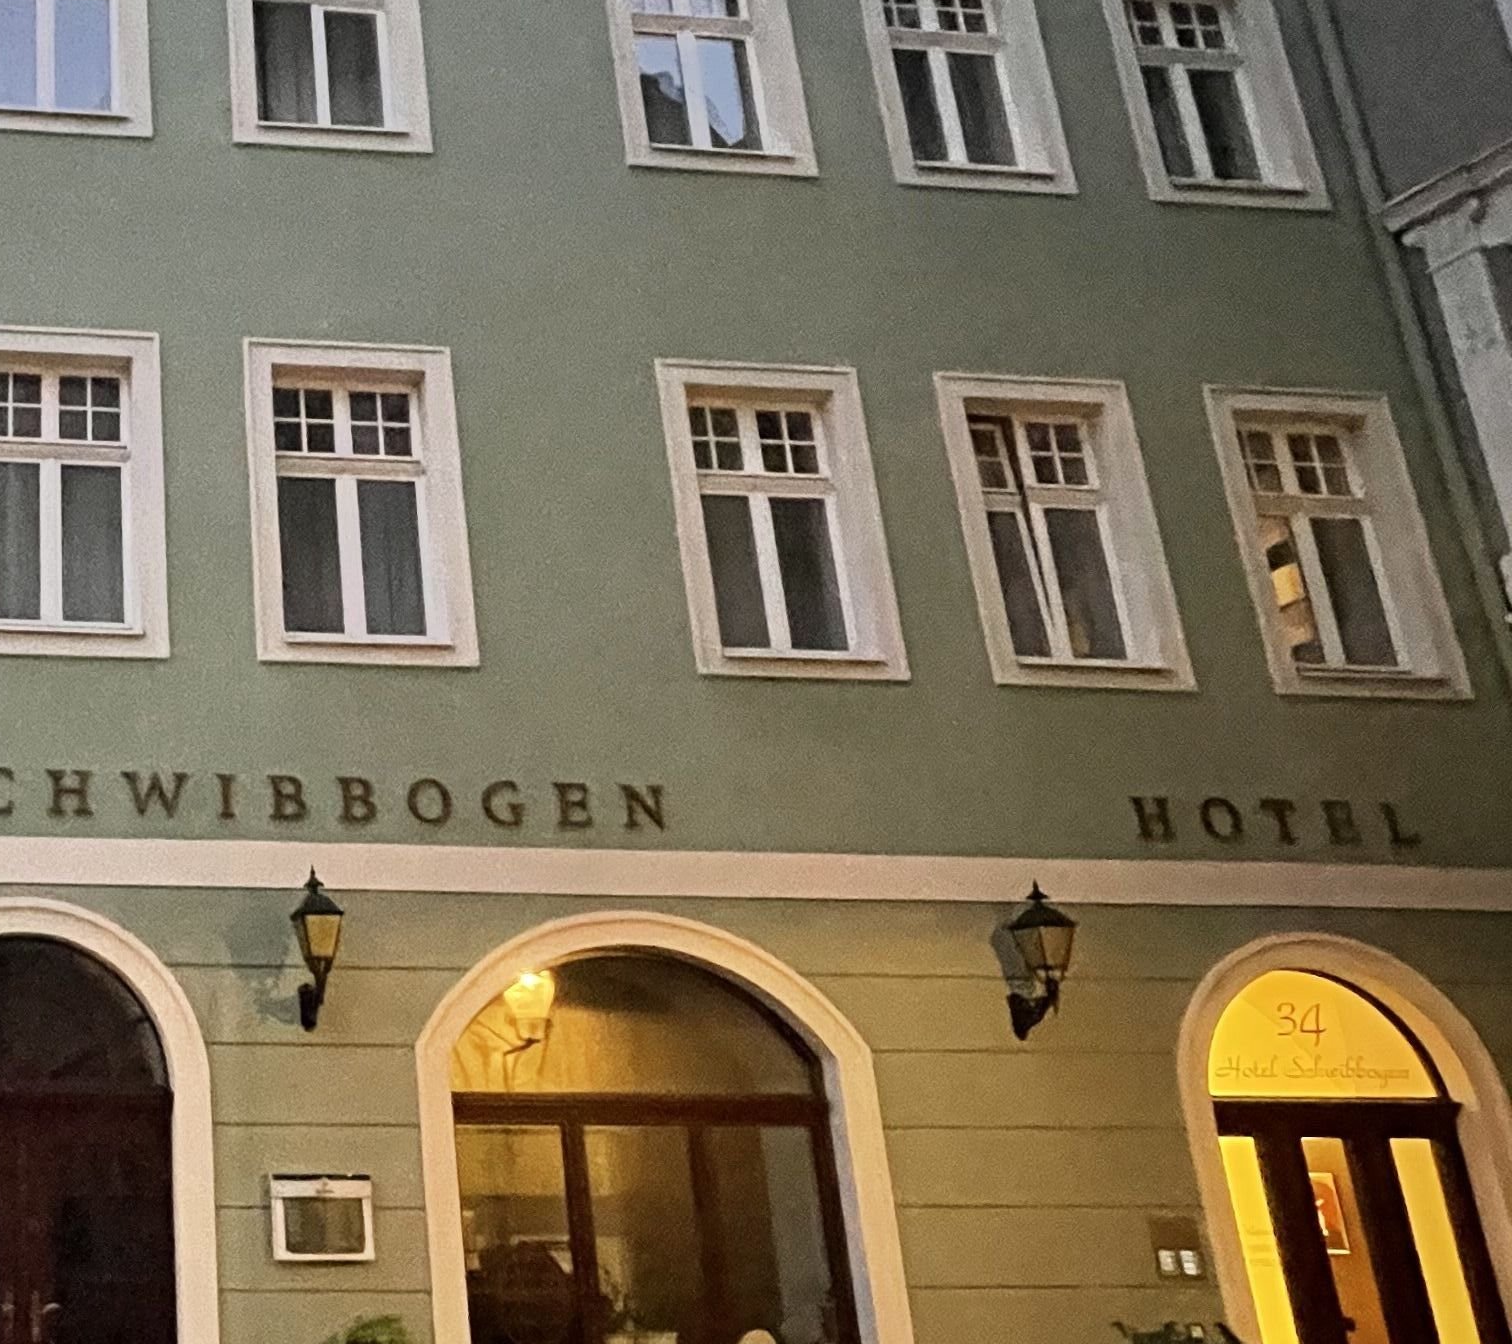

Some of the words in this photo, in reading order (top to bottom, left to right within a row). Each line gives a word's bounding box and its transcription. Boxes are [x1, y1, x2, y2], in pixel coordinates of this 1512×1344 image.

[1127, 794, 1423, 849] HOTEL
[1276, 1001, 1327, 1048] 34
[1214, 1054, 1278, 1079] Hotel
